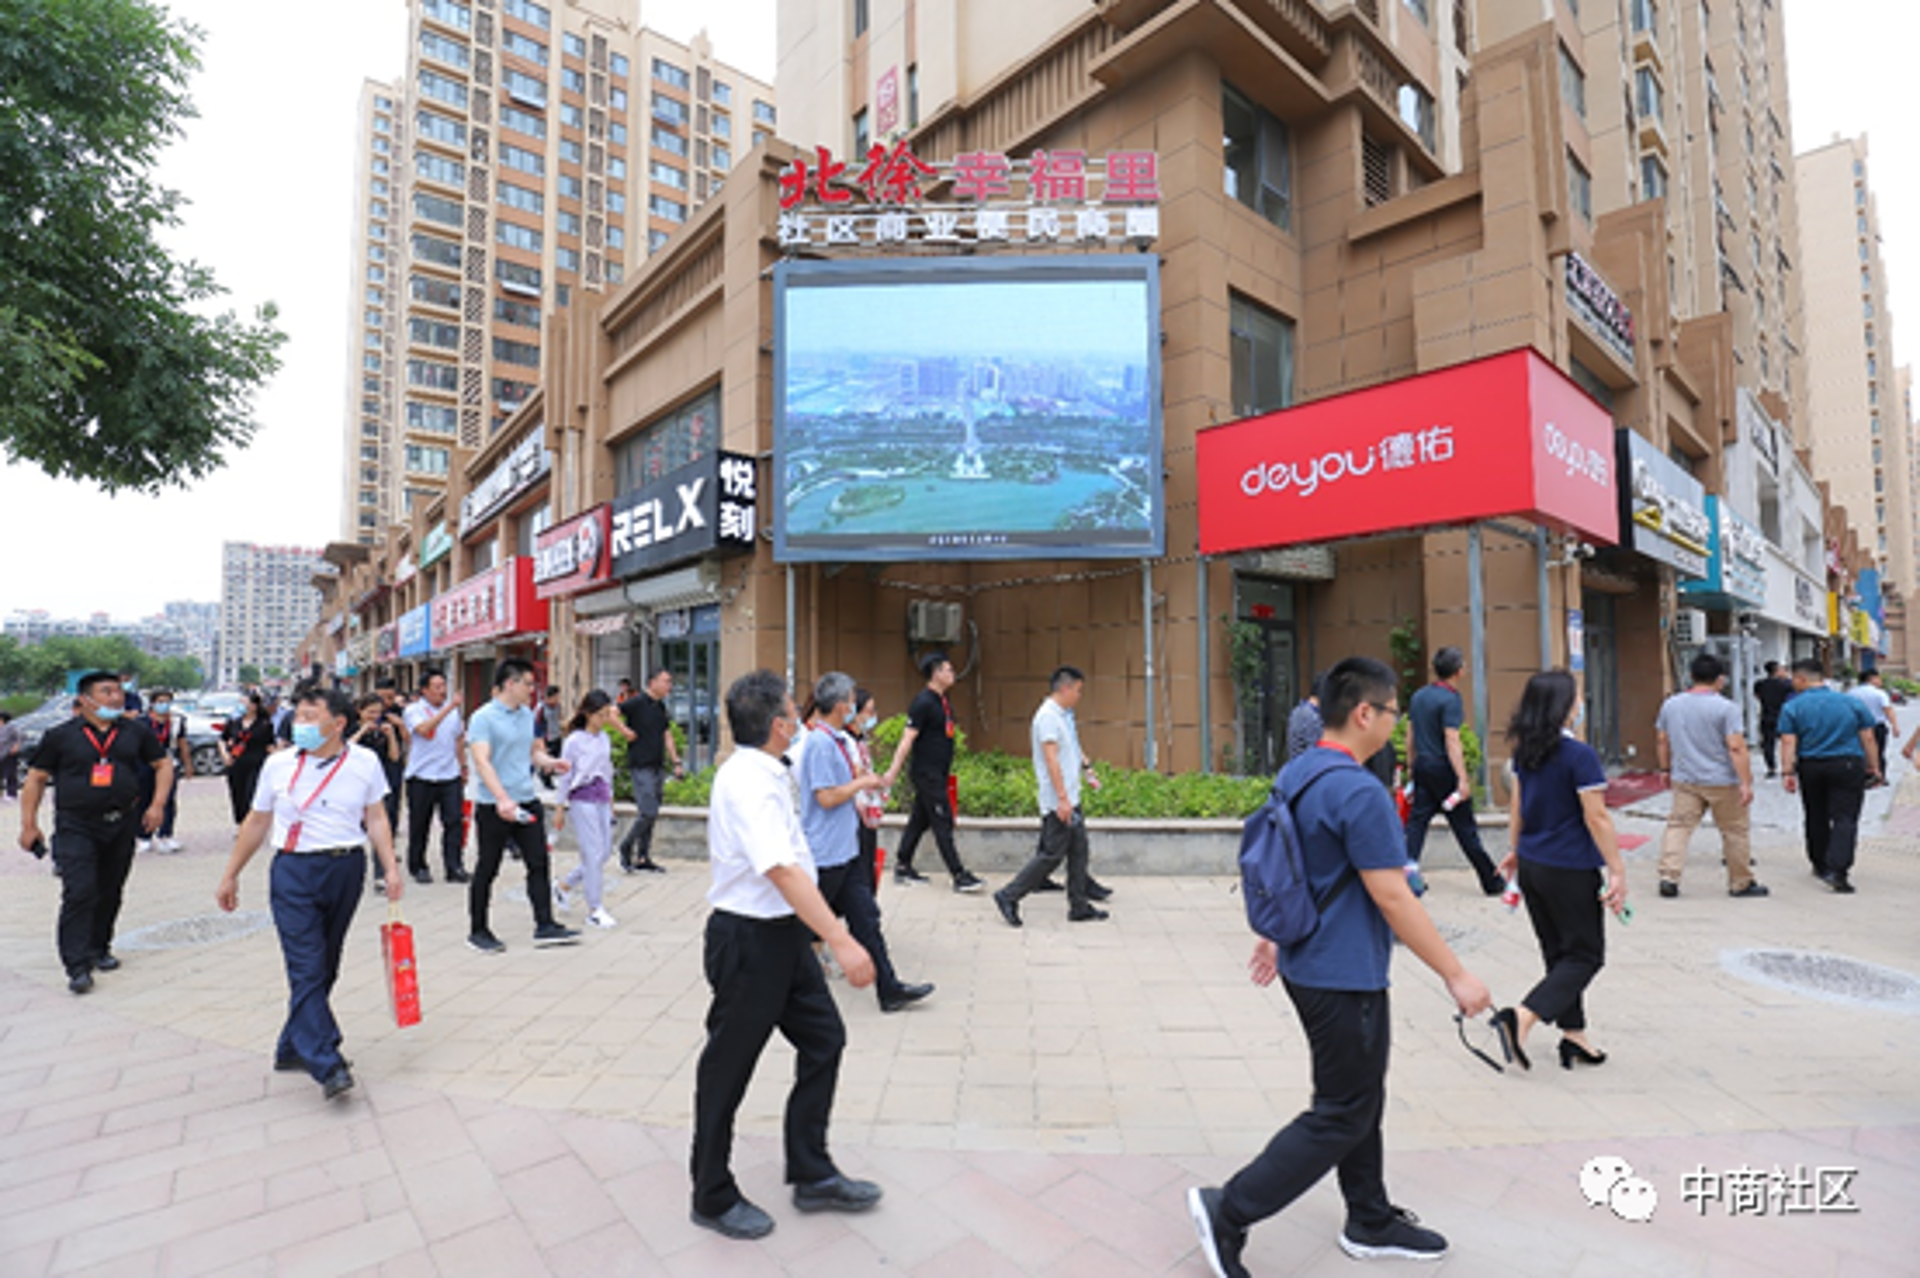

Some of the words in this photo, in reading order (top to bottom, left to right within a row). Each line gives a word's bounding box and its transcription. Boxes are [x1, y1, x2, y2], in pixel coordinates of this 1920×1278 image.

[779, 140, 1160, 208] 北徐幸福里
[611, 476, 707, 557] RELX
[719, 457, 756, 543] 悦刻
